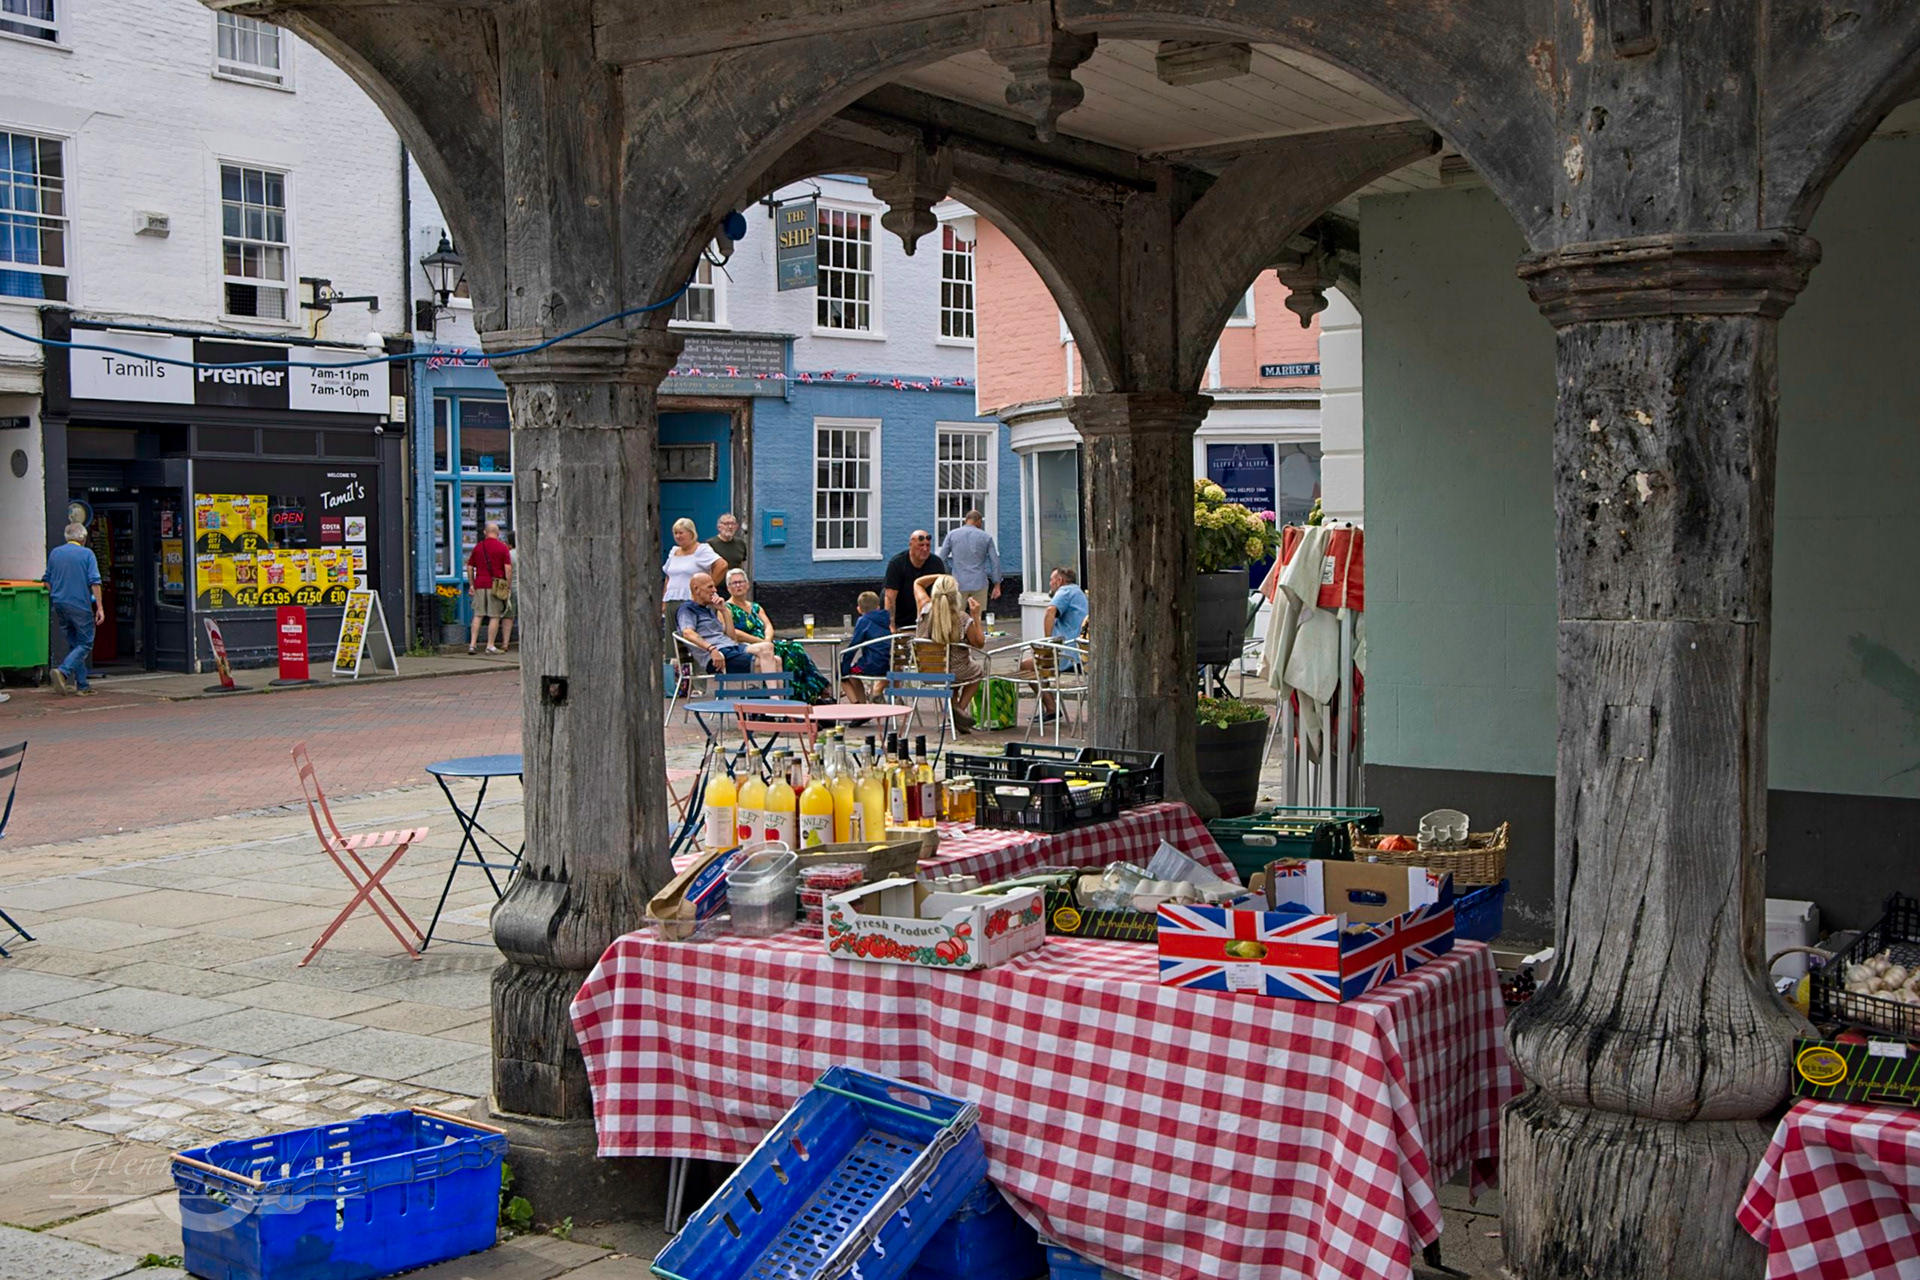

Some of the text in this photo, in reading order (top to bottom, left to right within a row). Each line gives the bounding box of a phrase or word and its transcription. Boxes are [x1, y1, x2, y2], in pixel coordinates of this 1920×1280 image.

[785, 210, 807, 224] THE
[779, 227, 815, 248] SHIP
[102, 357, 166, 378] Tamil's
[310, 367, 369, 382] 7am-11pm
[1265, 364, 1311, 376] MARKET
[198, 363, 285, 387] Premier
[310, 384, 370, 398] 7am-10pm
[320, 481, 365, 509] Tamil's
[273, 513, 304, 525] OPEN
[244, 538, 257, 550] £2
[262, 592, 291, 605] £3.95
[297, 591, 322, 604] £7.50
[330, 591, 346, 603] £10
[855, 919, 941, 937] Fresh Produce
